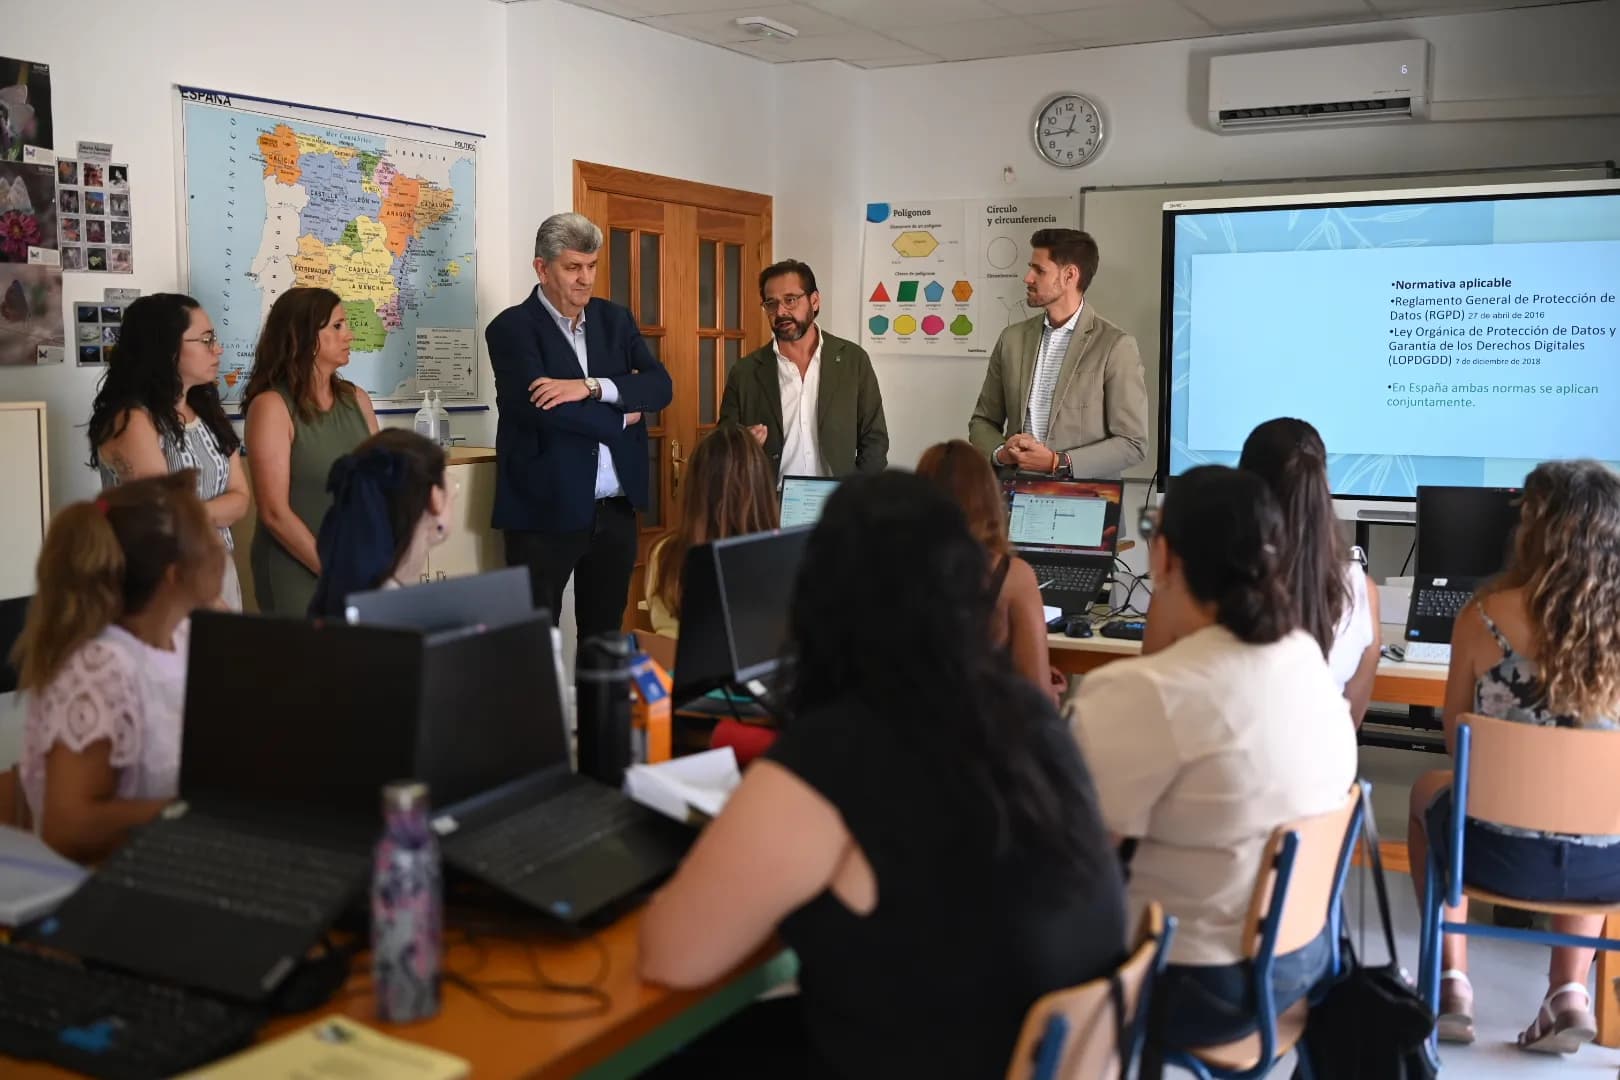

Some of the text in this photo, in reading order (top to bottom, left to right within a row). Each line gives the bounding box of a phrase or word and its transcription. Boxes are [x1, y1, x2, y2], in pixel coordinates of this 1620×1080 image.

[1056, 107, 1062, 115] 11
[1066, 102, 1074, 111] 12
[1048, 116, 1056, 125] 10
[1086, 114, 1092, 122] 2
[1090, 125, 1096, 133] 3
[1078, 148, 1085, 156] 5
[894, 208, 931, 218] Polígonos
[986, 204, 1018, 213] Círculo
[987, 214, 1056, 227] y circunferencia
[1396, 277, 1512, 290] Normativa aplicable
[1395, 292, 1615, 308] Reglamento General de Protección de
[1390, 311, 1422, 320] Datos
[1425, 310, 1464, 321] (RGPD)
[1394, 325, 1616, 338] Ley Orgánica de Protección de Datos y
[1440, 340, 1453, 350] de
[1457, 340, 1473, 350] los
[1477, 340, 1531, 350] Derechos
[1535, 340, 1585, 352] Digitales
[1388, 355, 1452, 367] (LOPDGDD)
[1392, 382, 1599, 396] En España ambas normas se aplican
[1386, 396, 1476, 408] conjuntamente.
